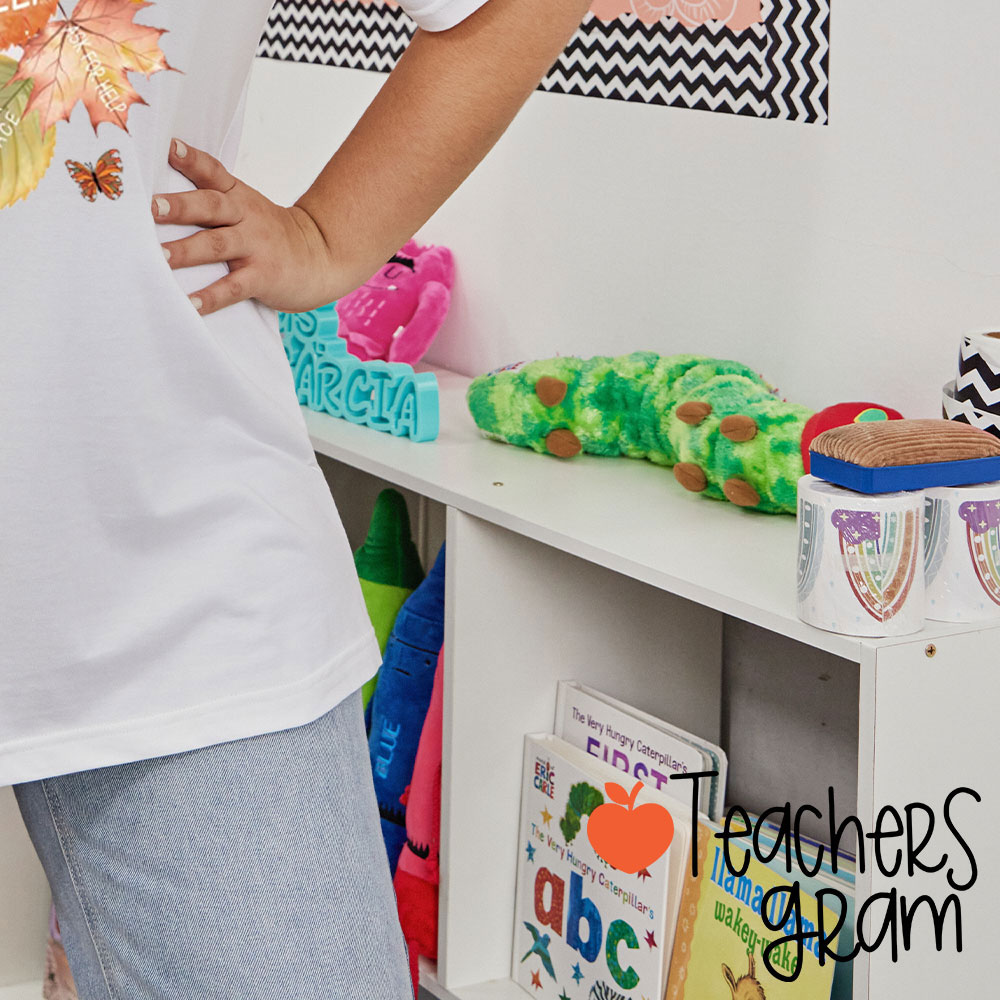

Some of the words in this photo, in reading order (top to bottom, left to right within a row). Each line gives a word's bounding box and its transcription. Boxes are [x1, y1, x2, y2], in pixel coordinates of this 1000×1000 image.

[82, 51, 105, 82] FOR
[96, 79, 127, 112] HELP
[374, 714, 401, 780] BLUE
[534, 761, 556, 786] ERIC
[571, 706, 586, 724] The
[586, 713, 605, 735] Very
[605, 724, 635, 752] Hungry
[636, 740, 689, 775] Caterpillar's
[533, 775, 555, 800] CARLE
[530, 823, 545, 842] The
[547, 834, 566, 861] Very
[565, 849, 597, 884] Hungry
[598, 872, 655, 921] Caterpillar's
[709, 845, 764, 916] llama
[534, 866, 640, 991] abc
